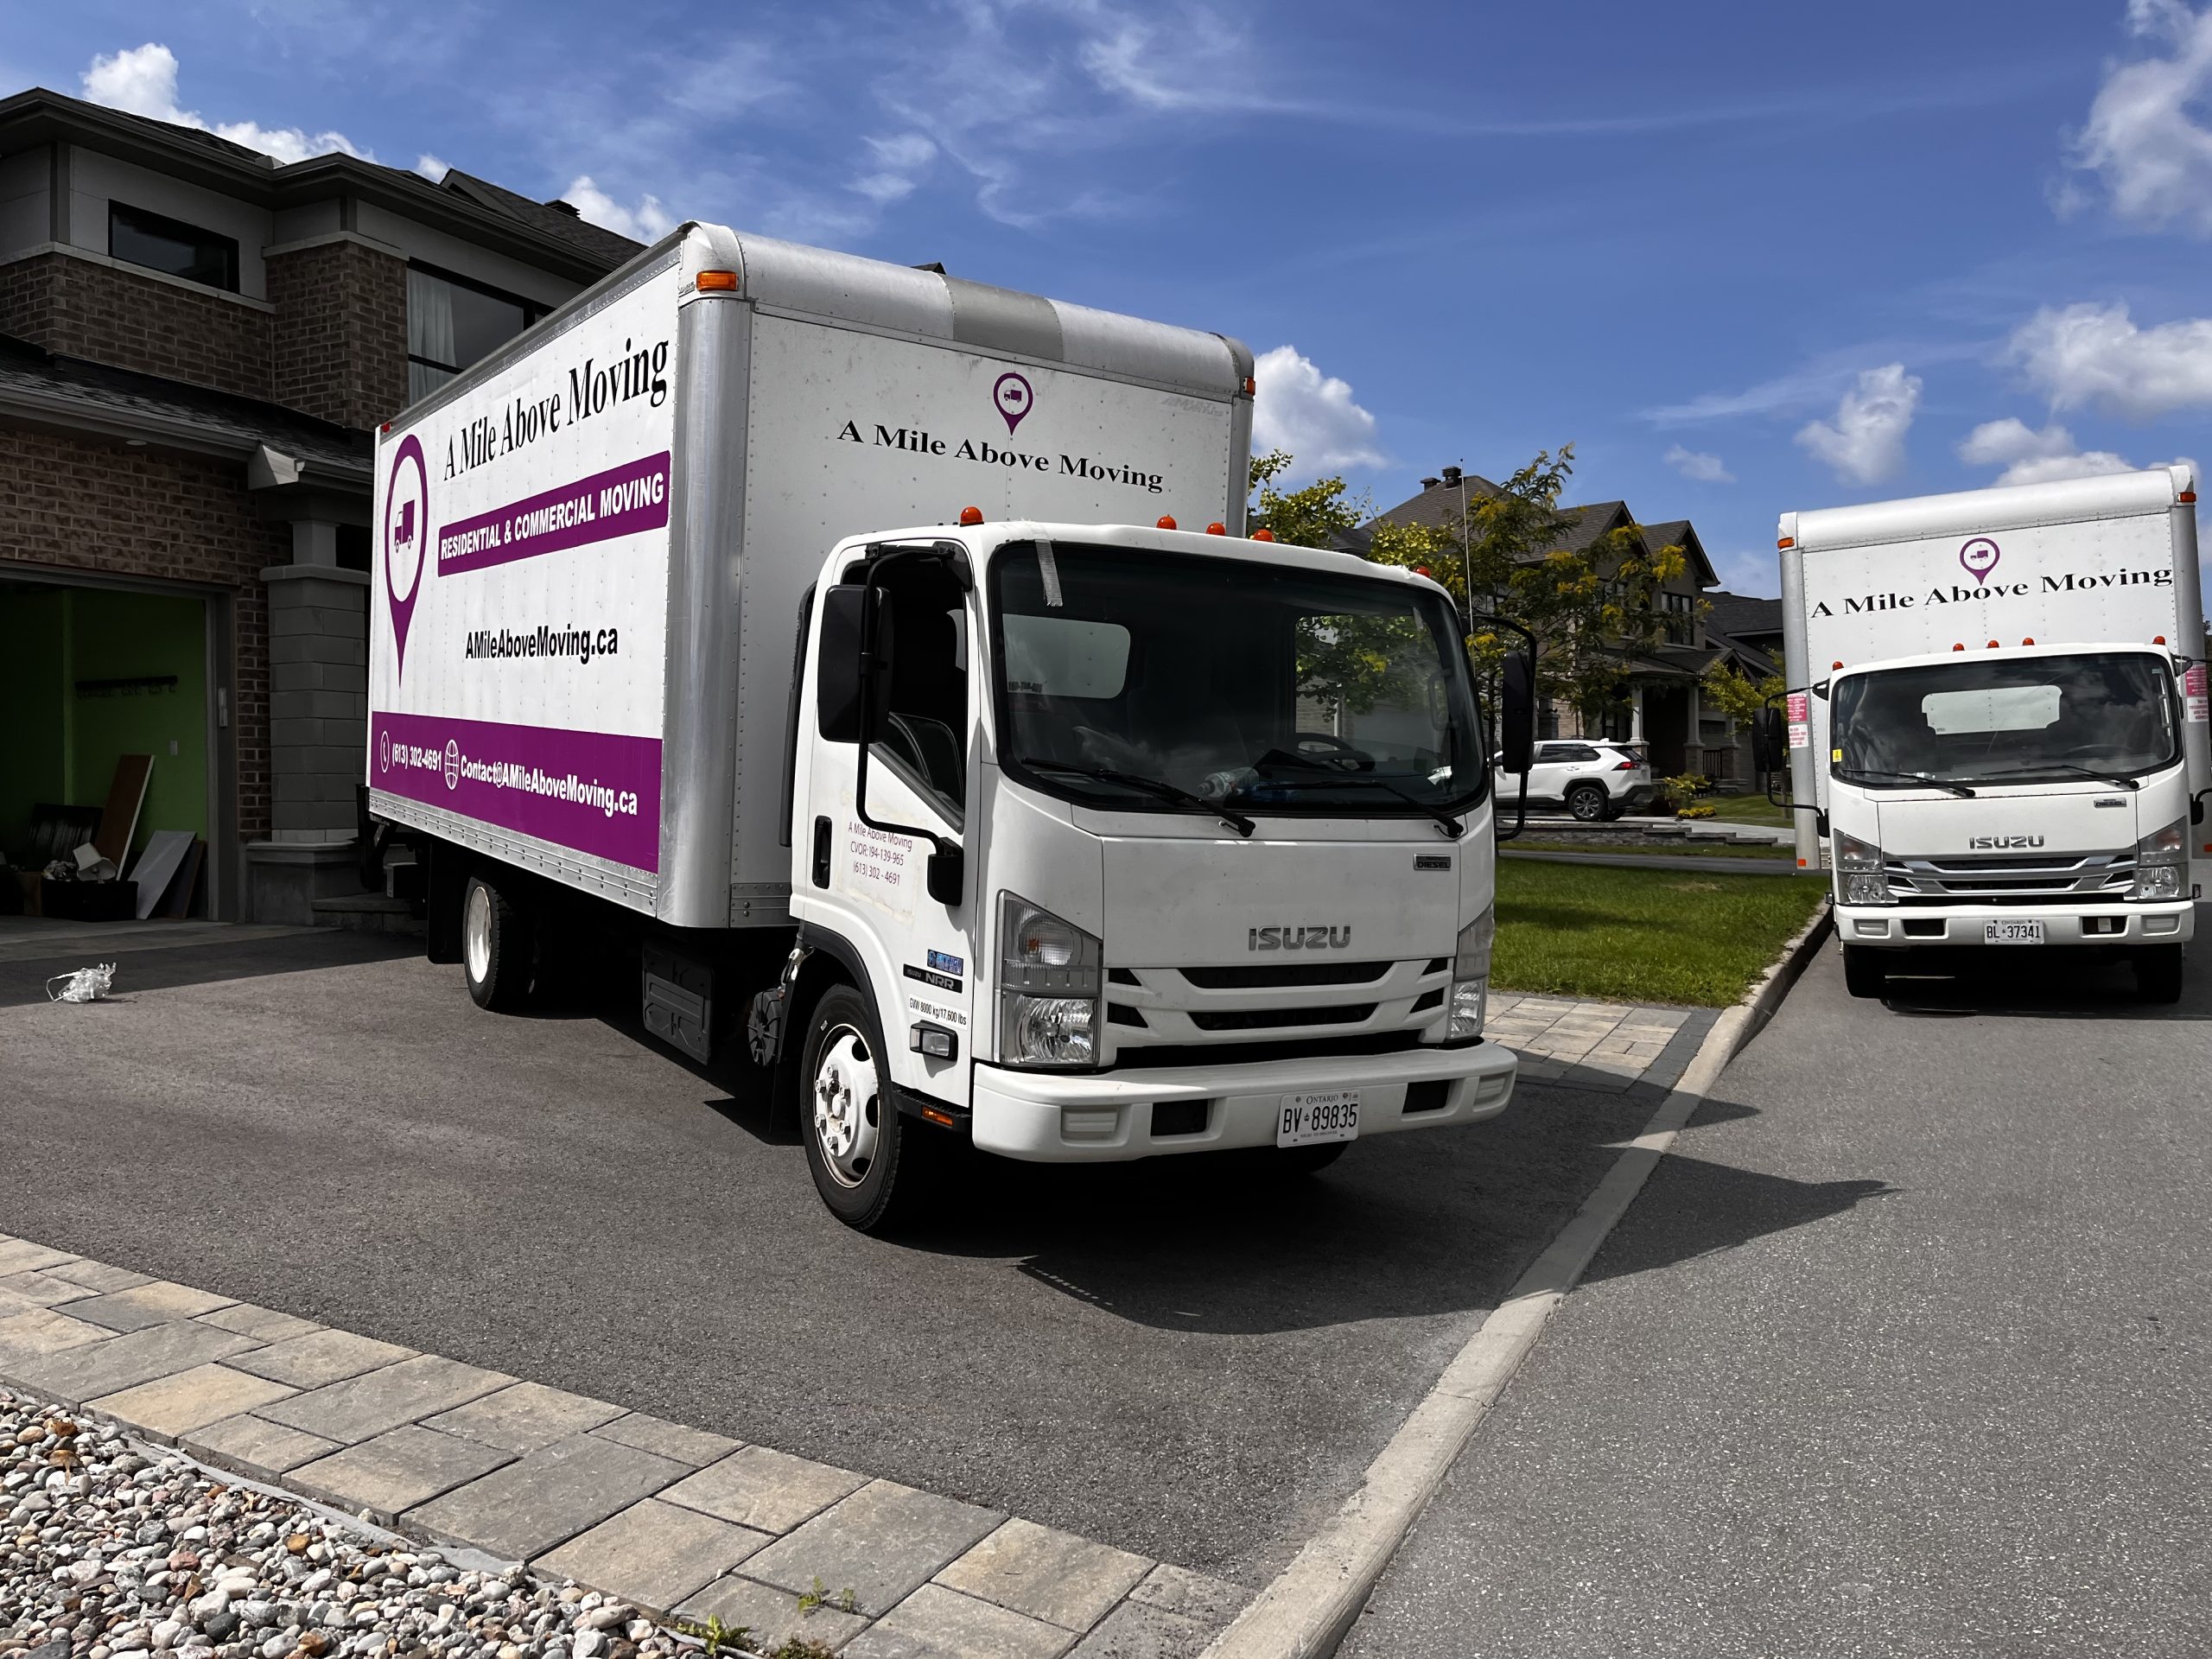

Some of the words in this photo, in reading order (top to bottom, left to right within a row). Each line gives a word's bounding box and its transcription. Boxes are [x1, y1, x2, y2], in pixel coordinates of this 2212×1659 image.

[443, 435, 455, 480] A
[460, 416, 496, 474] Mile
[499, 393, 560, 456] Above
[567, 338, 669, 426] Moving
[837, 420, 864, 443] A
[873, 424, 946, 455] Mile
[954, 439, 1050, 472] Above
[1058, 454, 1164, 494] Moving
[442, 524, 501, 560] RESIDENTIAL
[504, 520, 512, 543] &
[514, 494, 596, 541] COMMERCIAL
[600, 473, 664, 518] MOVING
[1811, 601, 1834, 618] A
[1843, 592, 1915, 614] Mile
[1924, 582, 2029, 606] Above
[2040, 568, 2173, 593] Moving
[465, 623, 619, 664] AMileAboveMoving.ca
[391, 743, 408, 768] (613)
[410, 747, 442, 772] 302-4691
[461, 754, 638, 817] Contact@AMileAboveMoving.ca
[849, 822, 853, 832] A
[1969, 835, 2044, 849] ISUZU
[868, 867, 880, 880] 302
[885, 871, 900, 886] 4691
[1249, 925, 1351, 951] ISUZU
[1986, 925, 2000, 938] BL
[2006, 925, 2040, 938] 37341
[925, 973, 954, 989] NRR
[958, 1012, 967, 1026] lbs
[1282, 1107, 1302, 1134] BV
[1312, 1103, 1358, 1131] 89835
